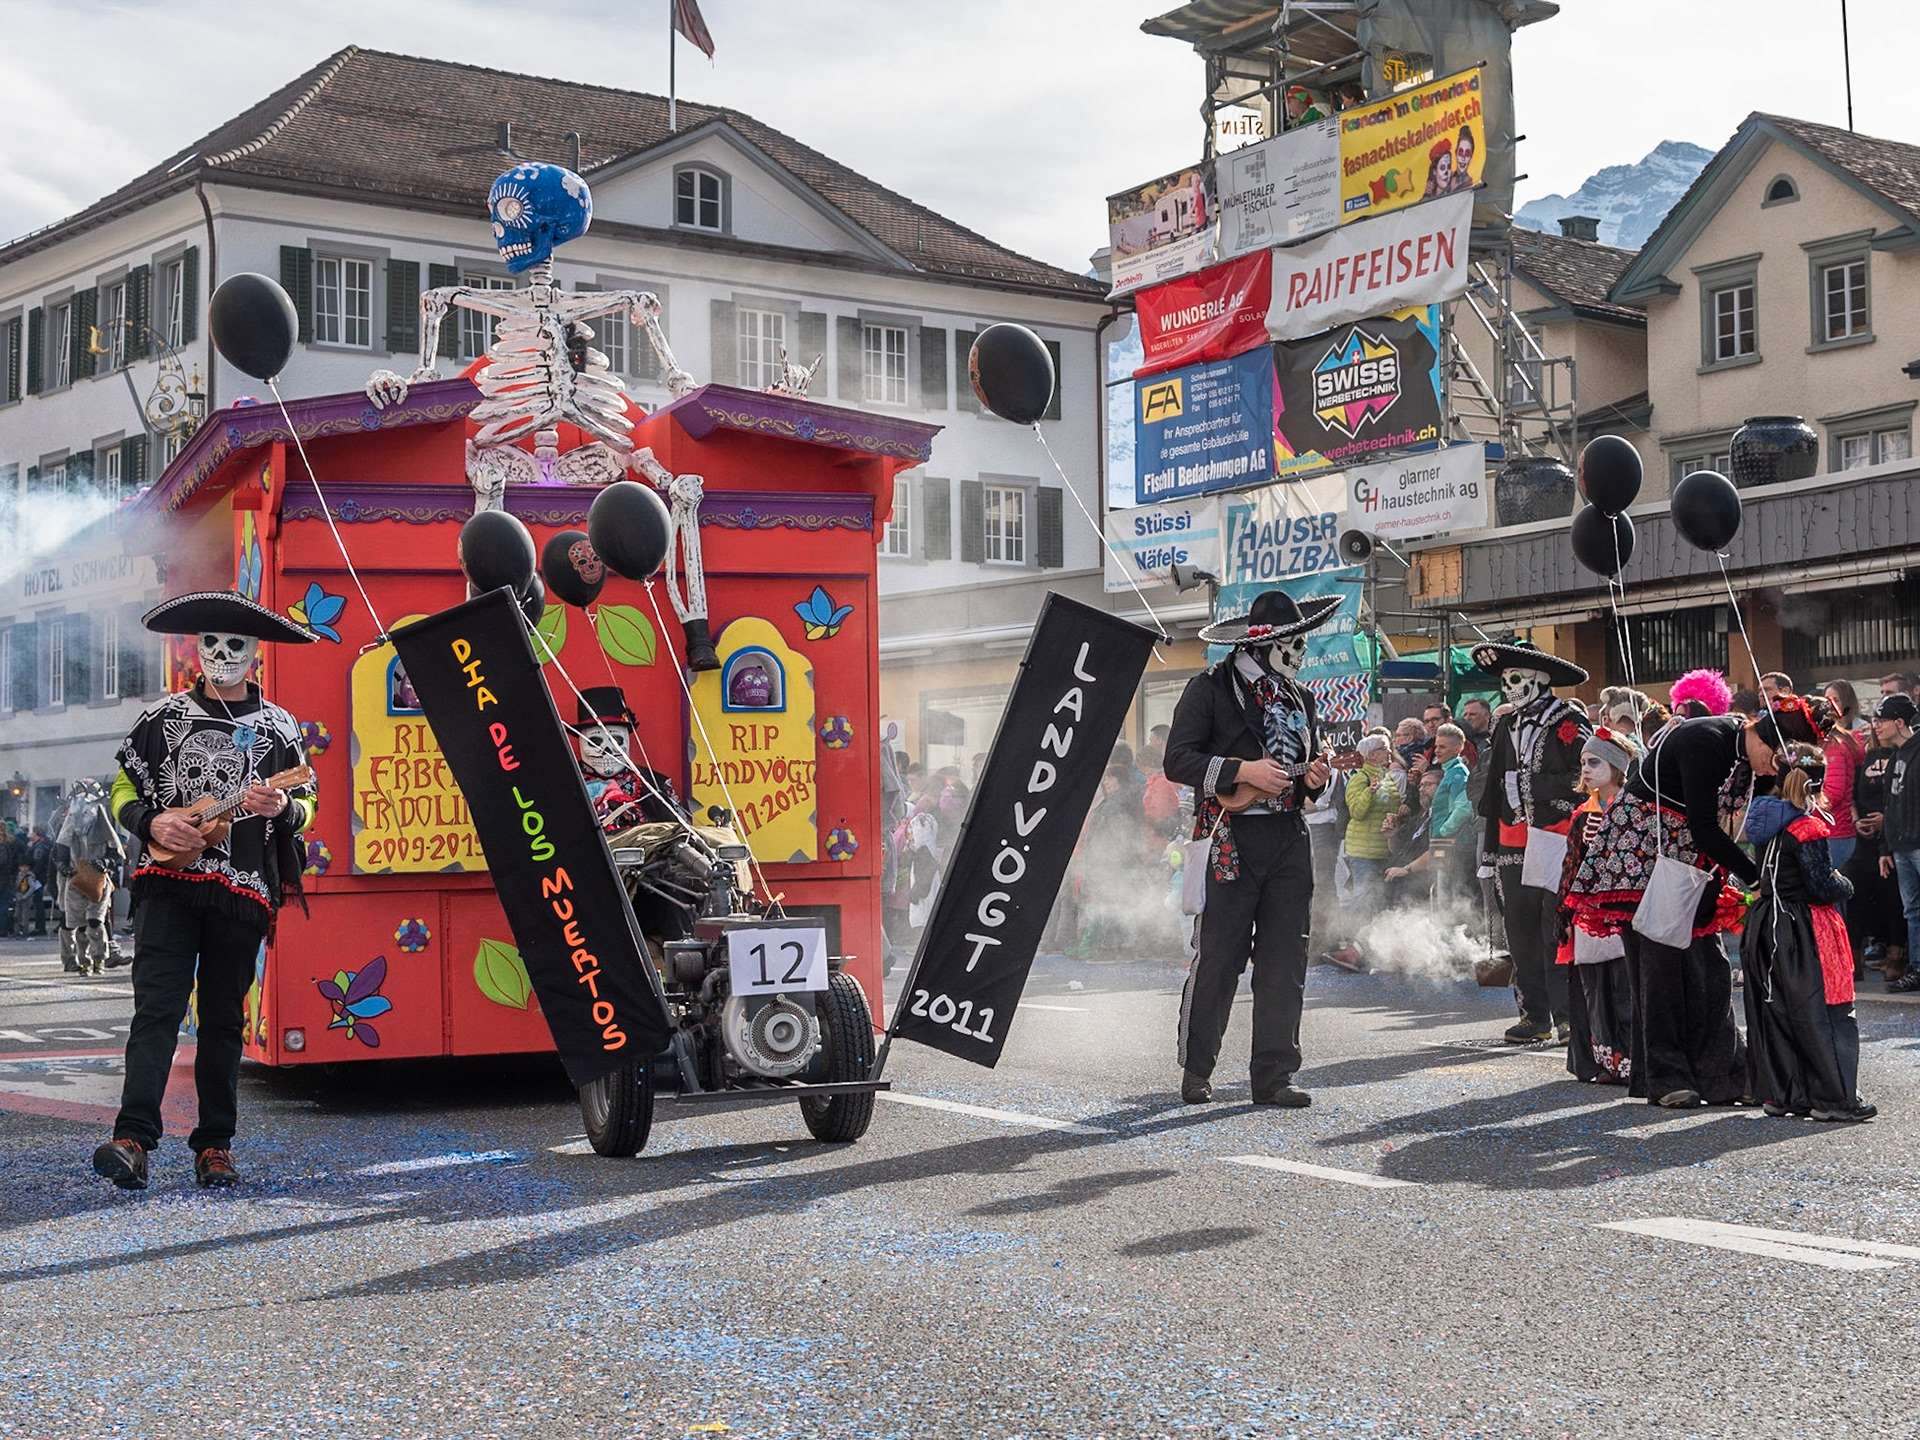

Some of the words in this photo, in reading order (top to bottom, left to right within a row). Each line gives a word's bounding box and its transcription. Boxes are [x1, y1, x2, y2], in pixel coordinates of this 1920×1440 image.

[1383, 59, 1425, 84] STEIN
[1341, 106, 1394, 134] Fasnacht
[1394, 101, 1410, 119] im
[1410, 75, 1479, 112] Glarnerland
[1343, 97, 1481, 177] fasnachtskalender.ch
[1223, 183, 1275, 210] MÜHLETHALER
[1244, 197, 1272, 215] FISCHLI
[1286, 227, 1456, 312] RAIFFEISEN
[1161, 297, 1225, 332] WUNDERLE
[1228, 289, 1244, 311] AG
[1317, 358, 1396, 397] SWISS
[1318, 381, 1396, 408] WERBETECHNIK
[1145, 384, 1180, 418] FA
[1164, 428, 1174, 440] Ihr
[1174, 416, 1231, 438] Ansprechpartner
[1232, 412, 1242, 424] für
[1169, 440, 1201, 460] gesamte
[1201, 429, 1249, 450] Gebäudehülle
[1280, 424, 1437, 470] swiss-werbetechnik.ch
[1144, 467, 1175, 494] Fischli
[1178, 455, 1248, 487] Bedachungen
[1250, 448, 1266, 472] AG
[1399, 466, 1441, 490] glarner
[1381, 482, 1456, 510] haustechnik
[1459, 481, 1478, 499] ag
[1134, 510, 1191, 536] Stüssi
[1239, 512, 1337, 551] HAUSER
[1374, 510, 1451, 533] glarner-haustechnik.ch
[1134, 546, 1188, 570] Näfels
[1240, 543, 1350, 580] HOLZBA
[24, 568, 62, 597] HOTEL
[72, 555, 134, 587] SCHWERT
[1340, 617, 1353, 633] AG
[1325, 726, 1356, 747] ruck
[370, 756, 459, 799] ERBE
[693, 756, 816, 787] LANDVÖGT
[964, 641, 1097, 973] LANDVÖGT
[451, 638, 498, 711] DIA
[489, 722, 520, 771] DE
[512, 786, 555, 862] LOS
[542, 866, 628, 1051] MUERTOS
[749, 940, 808, 986] 12
[910, 988, 994, 1044] 2011
